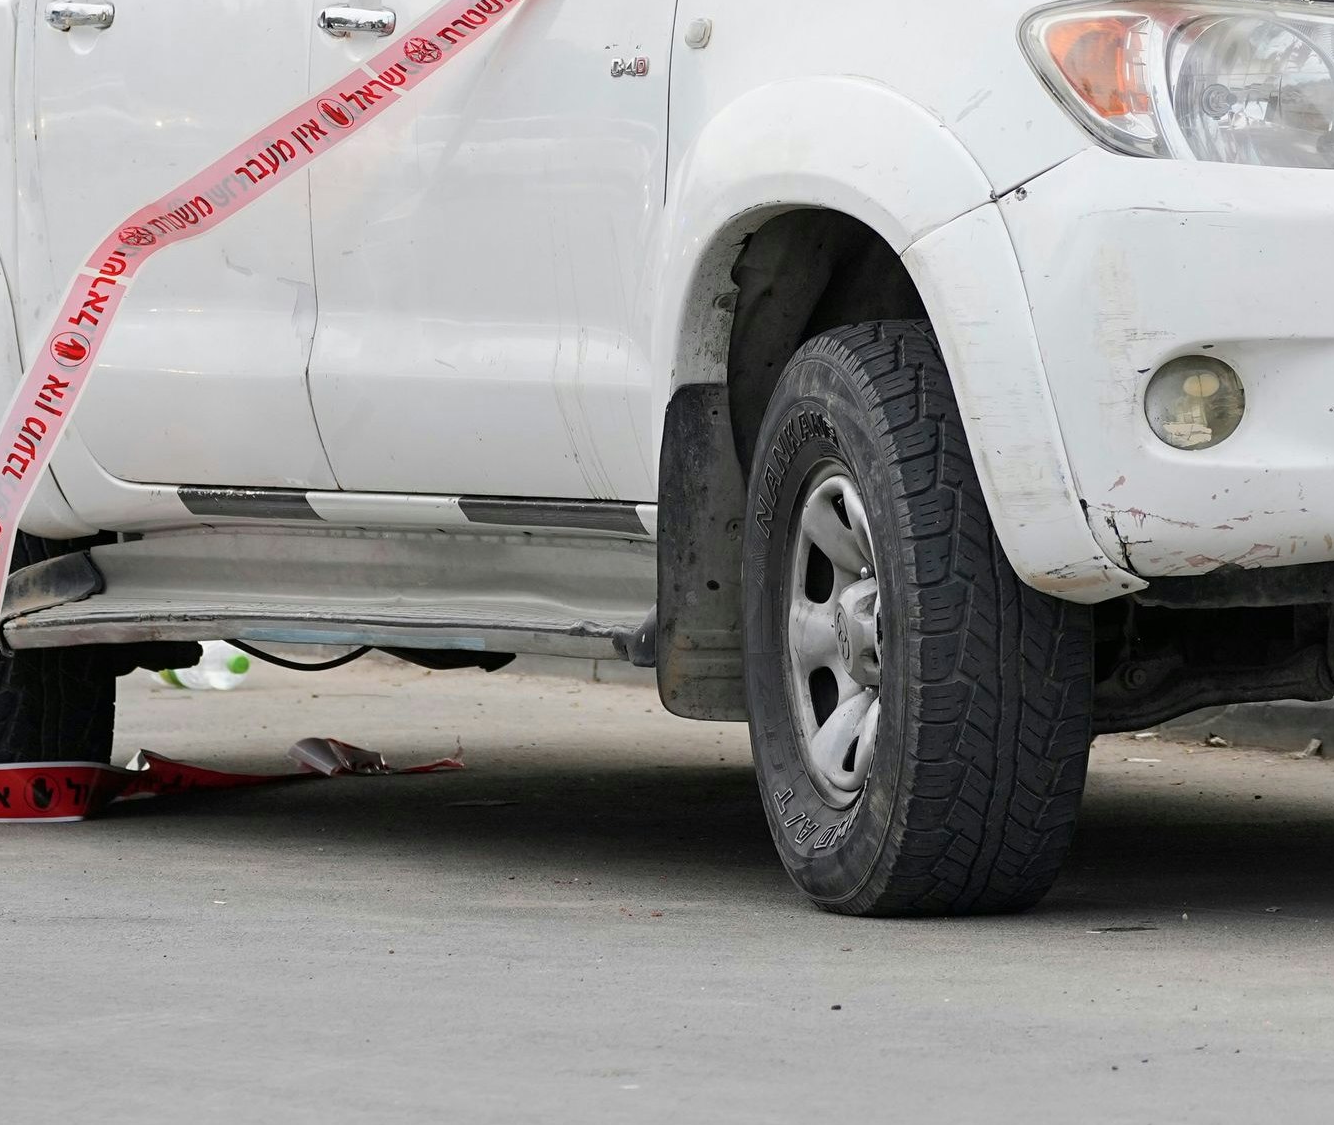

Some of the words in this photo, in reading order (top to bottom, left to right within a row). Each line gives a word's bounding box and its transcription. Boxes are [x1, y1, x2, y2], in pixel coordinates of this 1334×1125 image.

[339, 62, 407, 111] ישראל
[290, 118, 328, 154] אין
[234, 138, 296, 184] מעבר
[68, 250, 127, 327] ישראל
[34, 374, 70, 417] אין
[1, 416, 47, 480] מעבר
